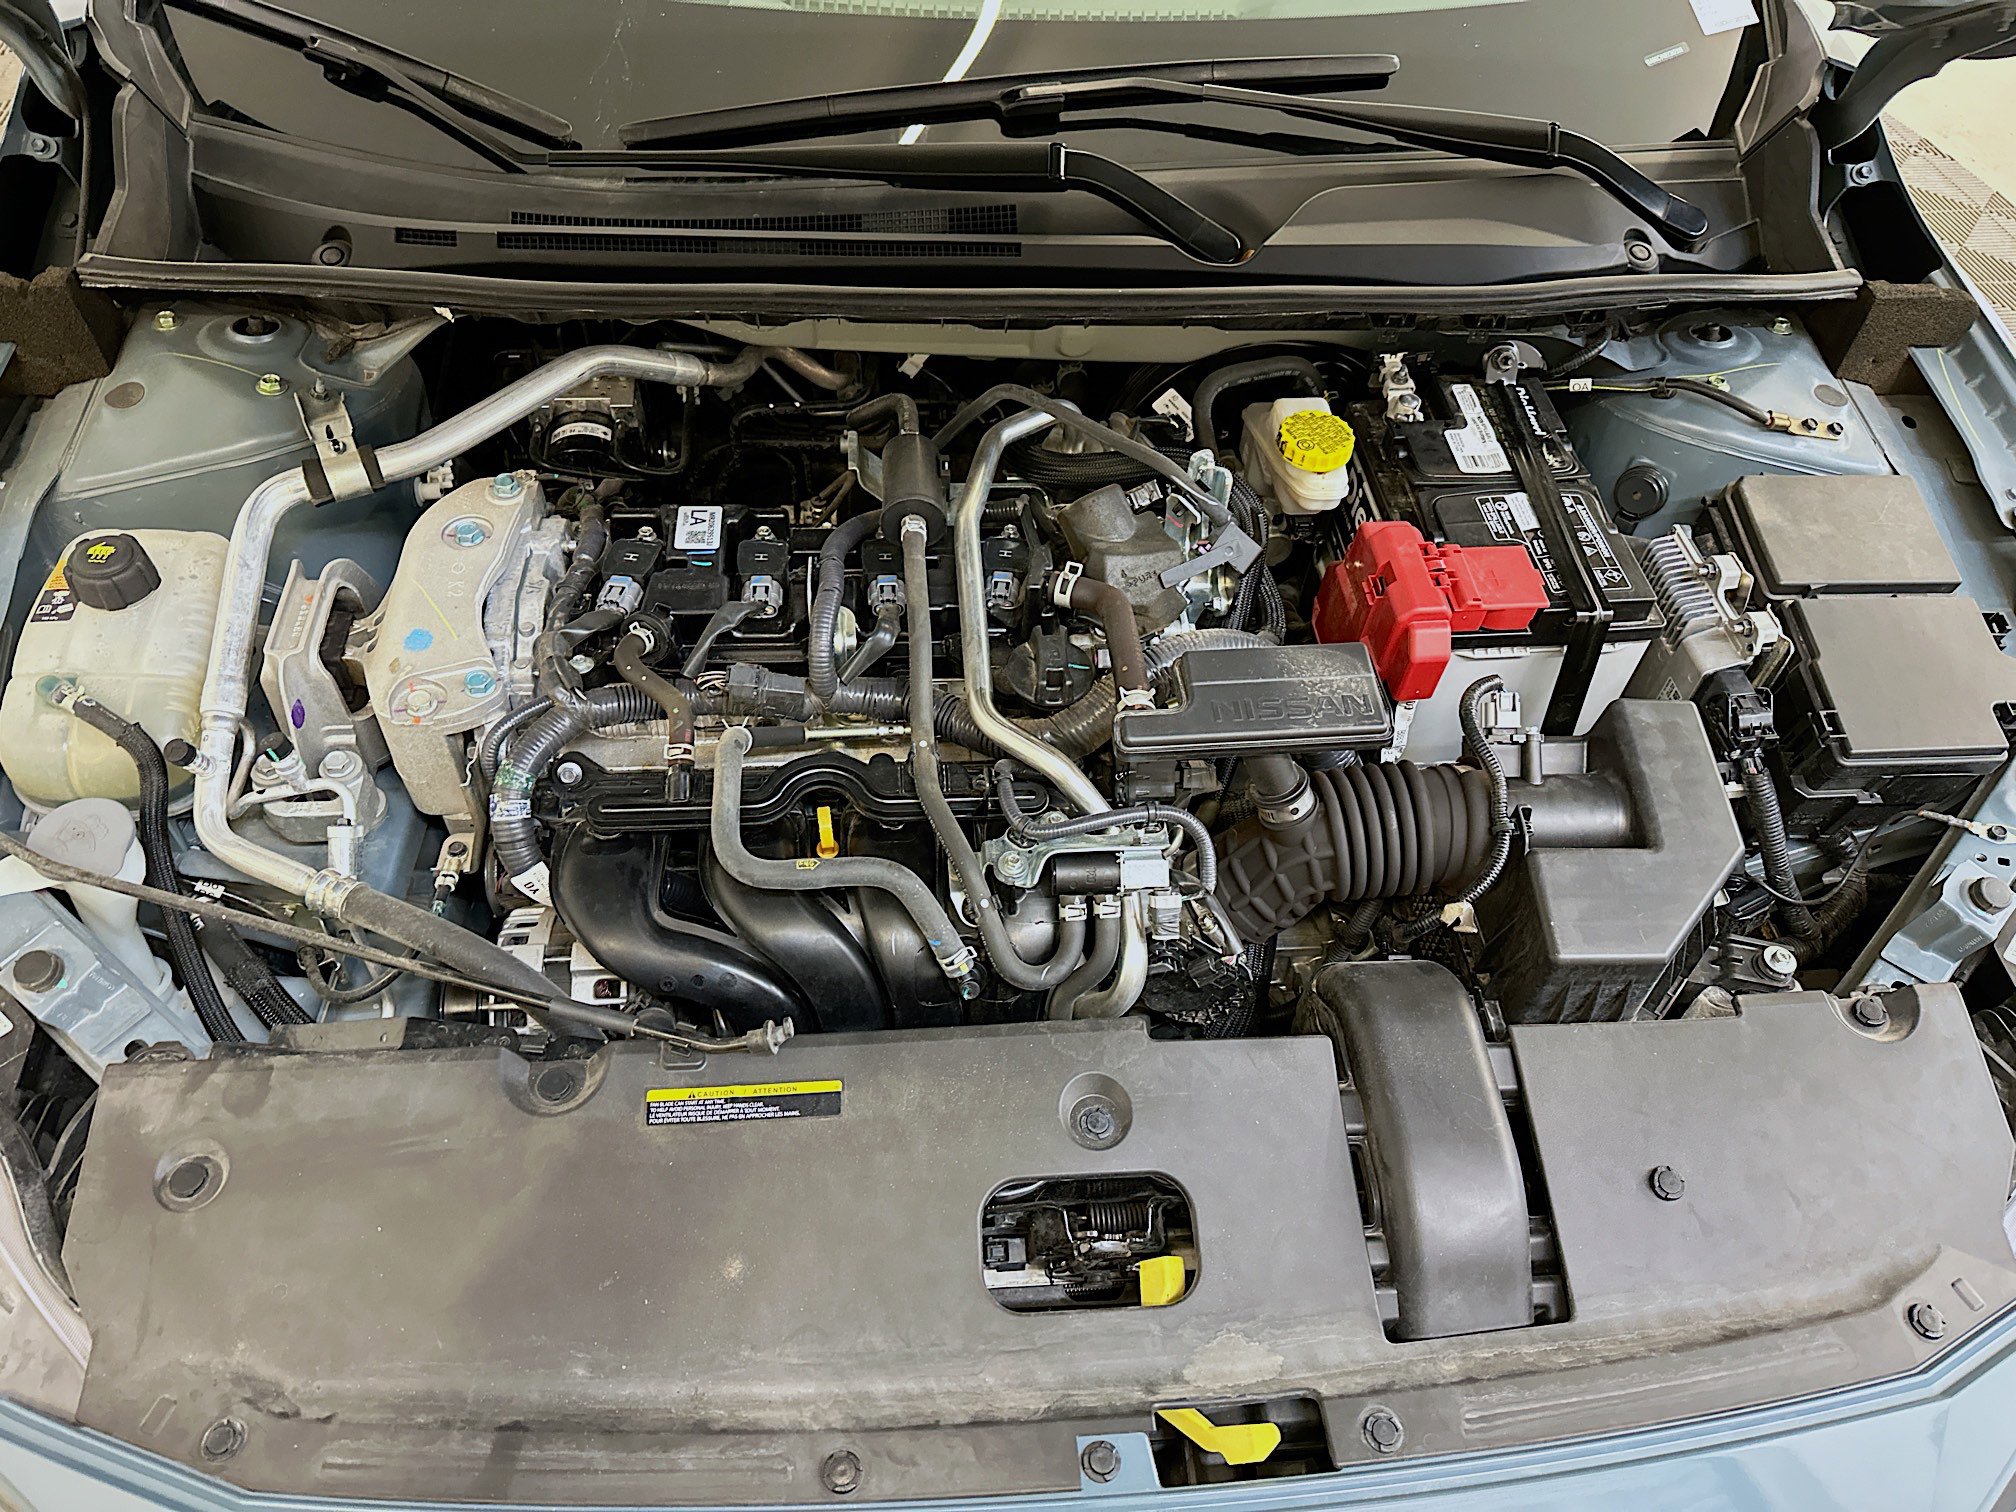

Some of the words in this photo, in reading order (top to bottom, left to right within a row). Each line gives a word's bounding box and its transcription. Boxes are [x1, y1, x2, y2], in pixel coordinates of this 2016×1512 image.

[690, 510, 708, 526] LA
[1210, 694, 1374, 723] NISSAN
[697, 1090, 734, 1098] CAUTION
[752, 1086, 798, 1094] ATTENTION
